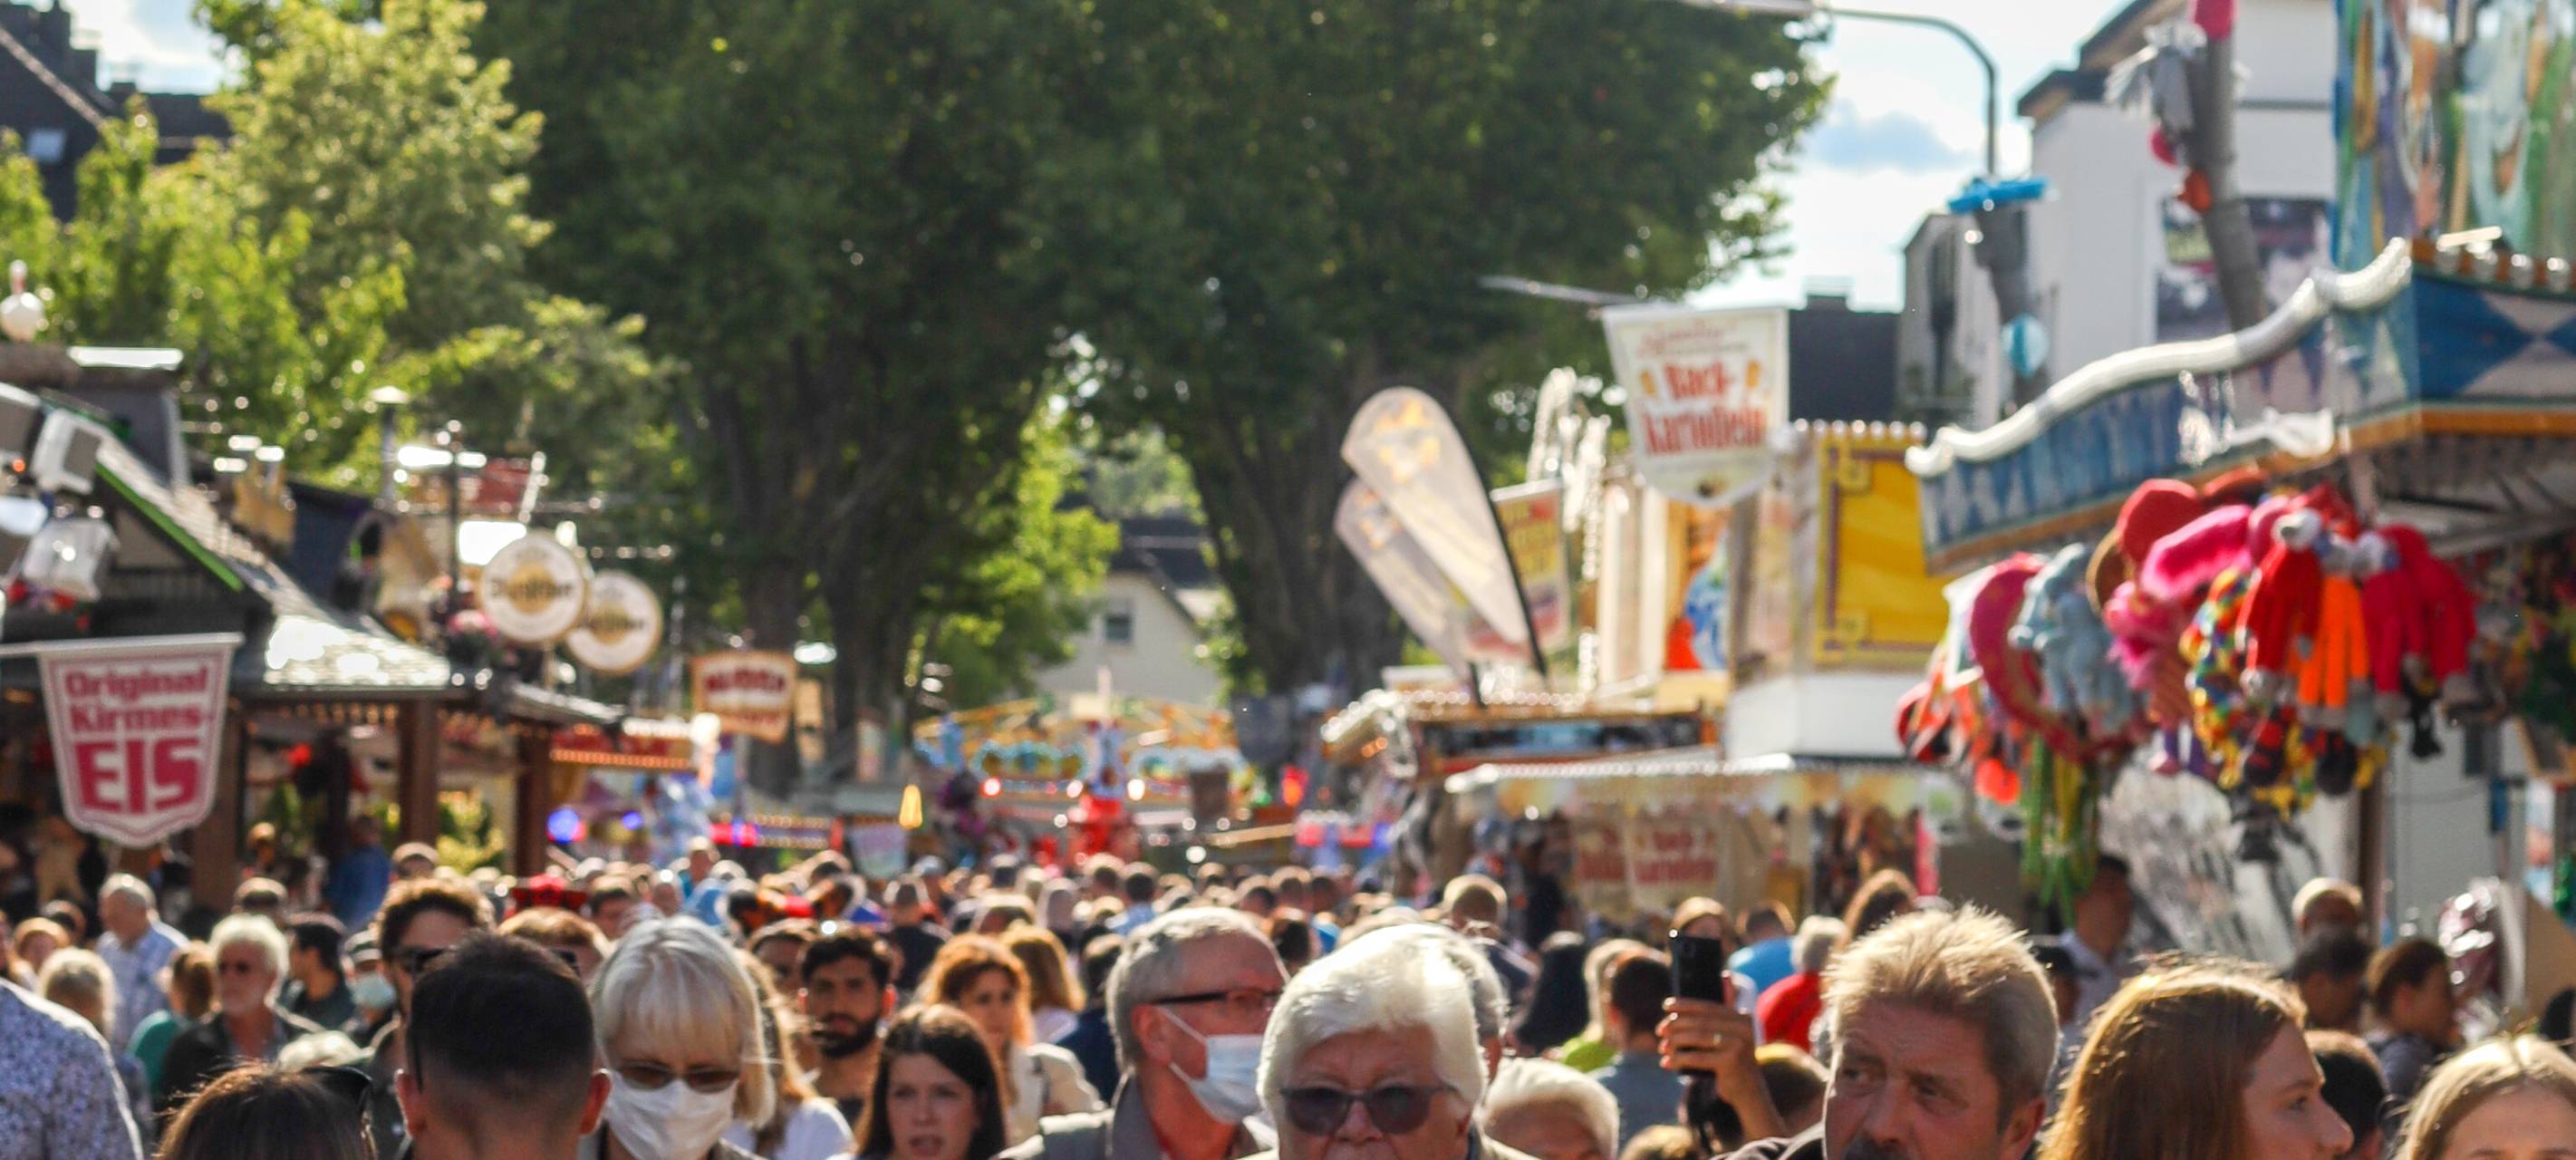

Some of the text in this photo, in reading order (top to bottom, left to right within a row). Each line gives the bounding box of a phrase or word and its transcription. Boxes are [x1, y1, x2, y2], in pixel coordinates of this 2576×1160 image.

[63, 664, 208, 701] Original
[68, 705, 217, 732] Kirmes-
[72, 736, 200, 814] EIS
